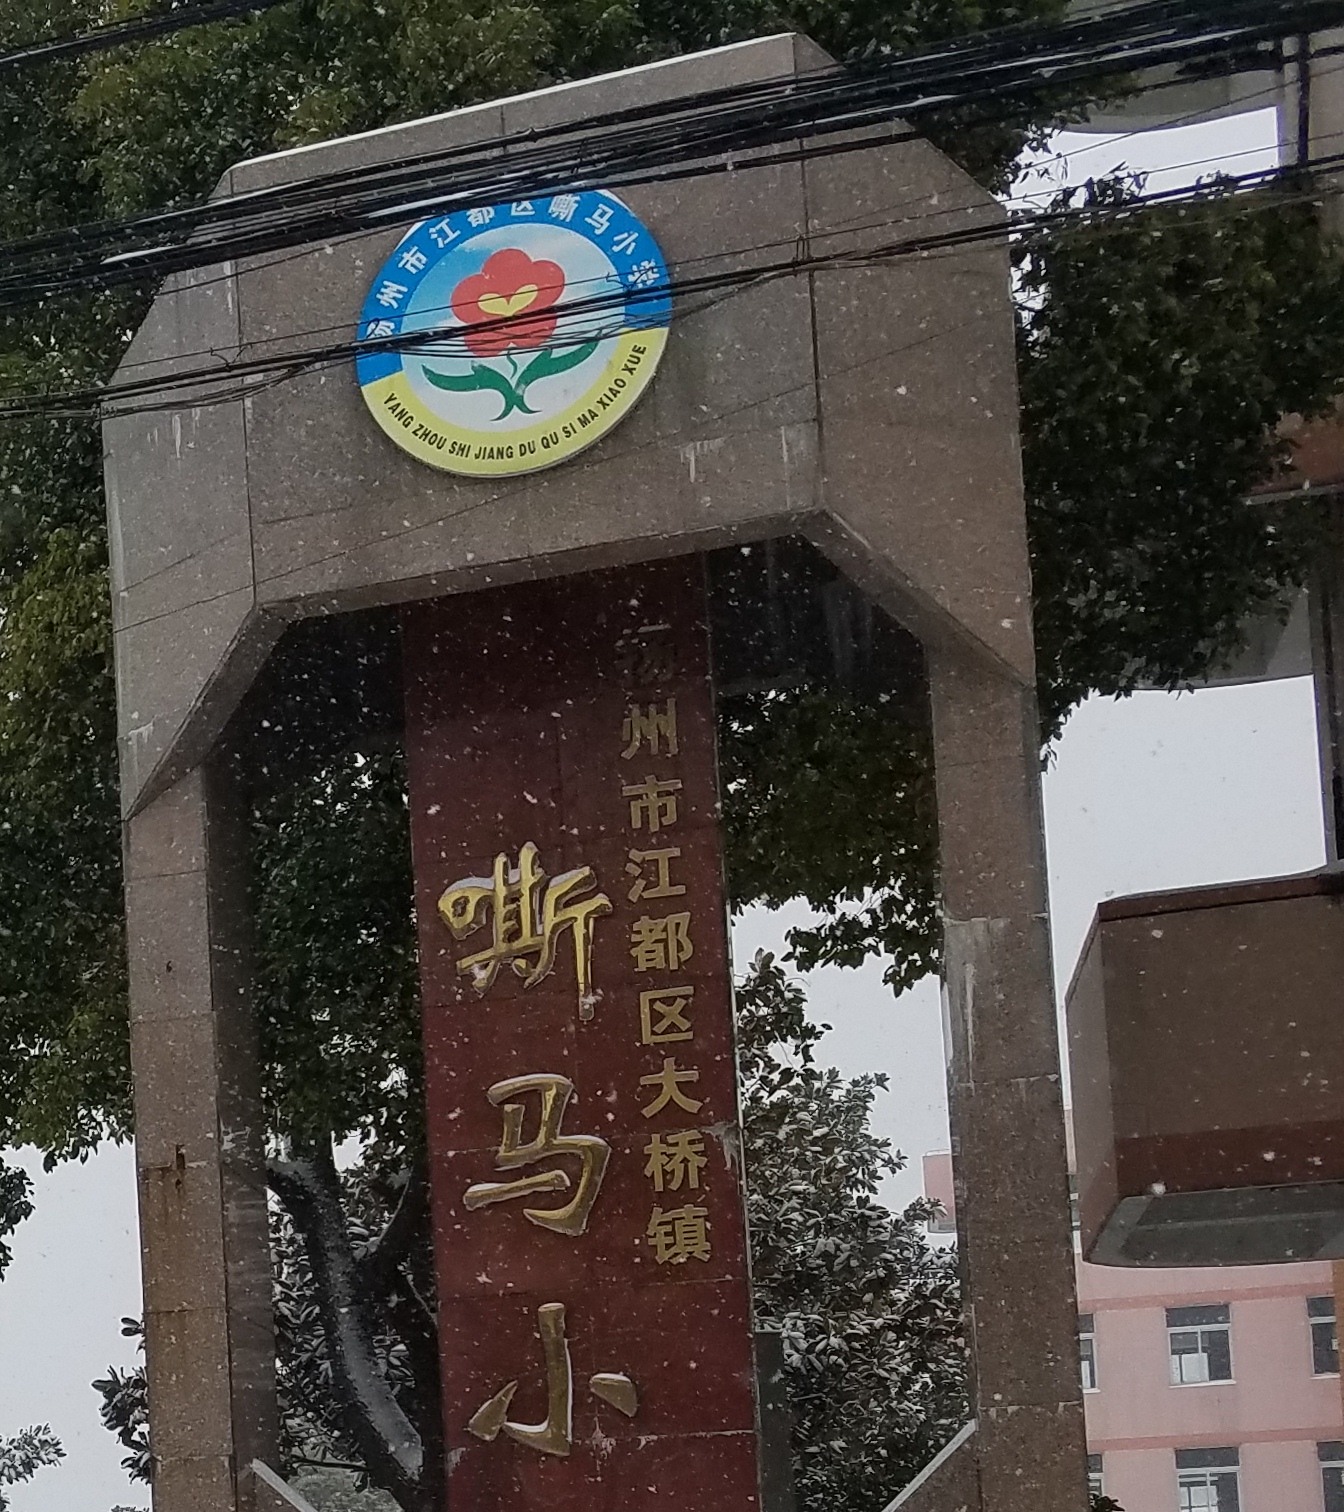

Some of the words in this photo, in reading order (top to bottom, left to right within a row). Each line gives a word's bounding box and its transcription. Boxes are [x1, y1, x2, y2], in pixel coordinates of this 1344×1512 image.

[384, 392, 414, 428] YANG
[412, 423, 447, 450] ZHOU
[448, 441, 471, 458] SHI
[474, 445, 513, 460] JIANG
[519, 440, 536, 457] DU
[541, 431, 559, 449] QU
[562, 422, 577, 438] SI
[577, 408, 599, 428] MA
[596, 378, 627, 410] XIAO
[621, 344, 647, 375] XUE
